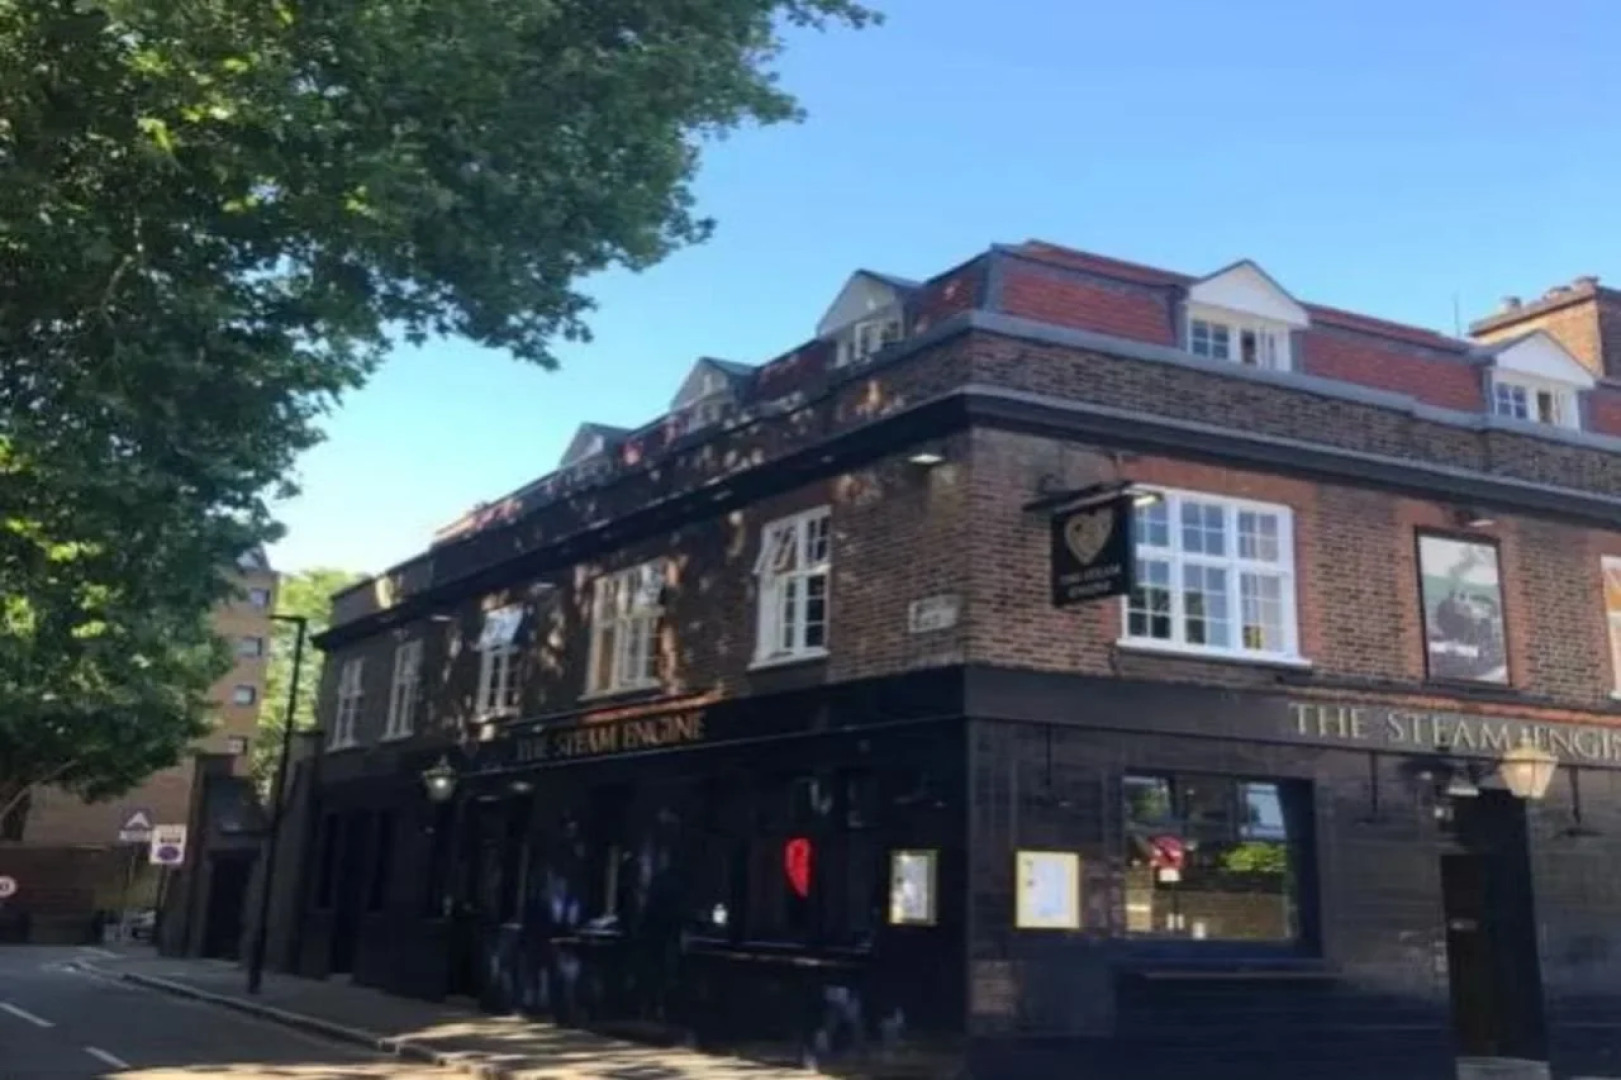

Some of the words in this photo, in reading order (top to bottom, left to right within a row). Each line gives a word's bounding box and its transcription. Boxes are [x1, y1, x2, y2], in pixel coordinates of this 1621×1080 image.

[622, 709, 706, 748] ENGINE
[1288, 702, 1369, 740] THE
[1386, 708, 1513, 750] STEAM
